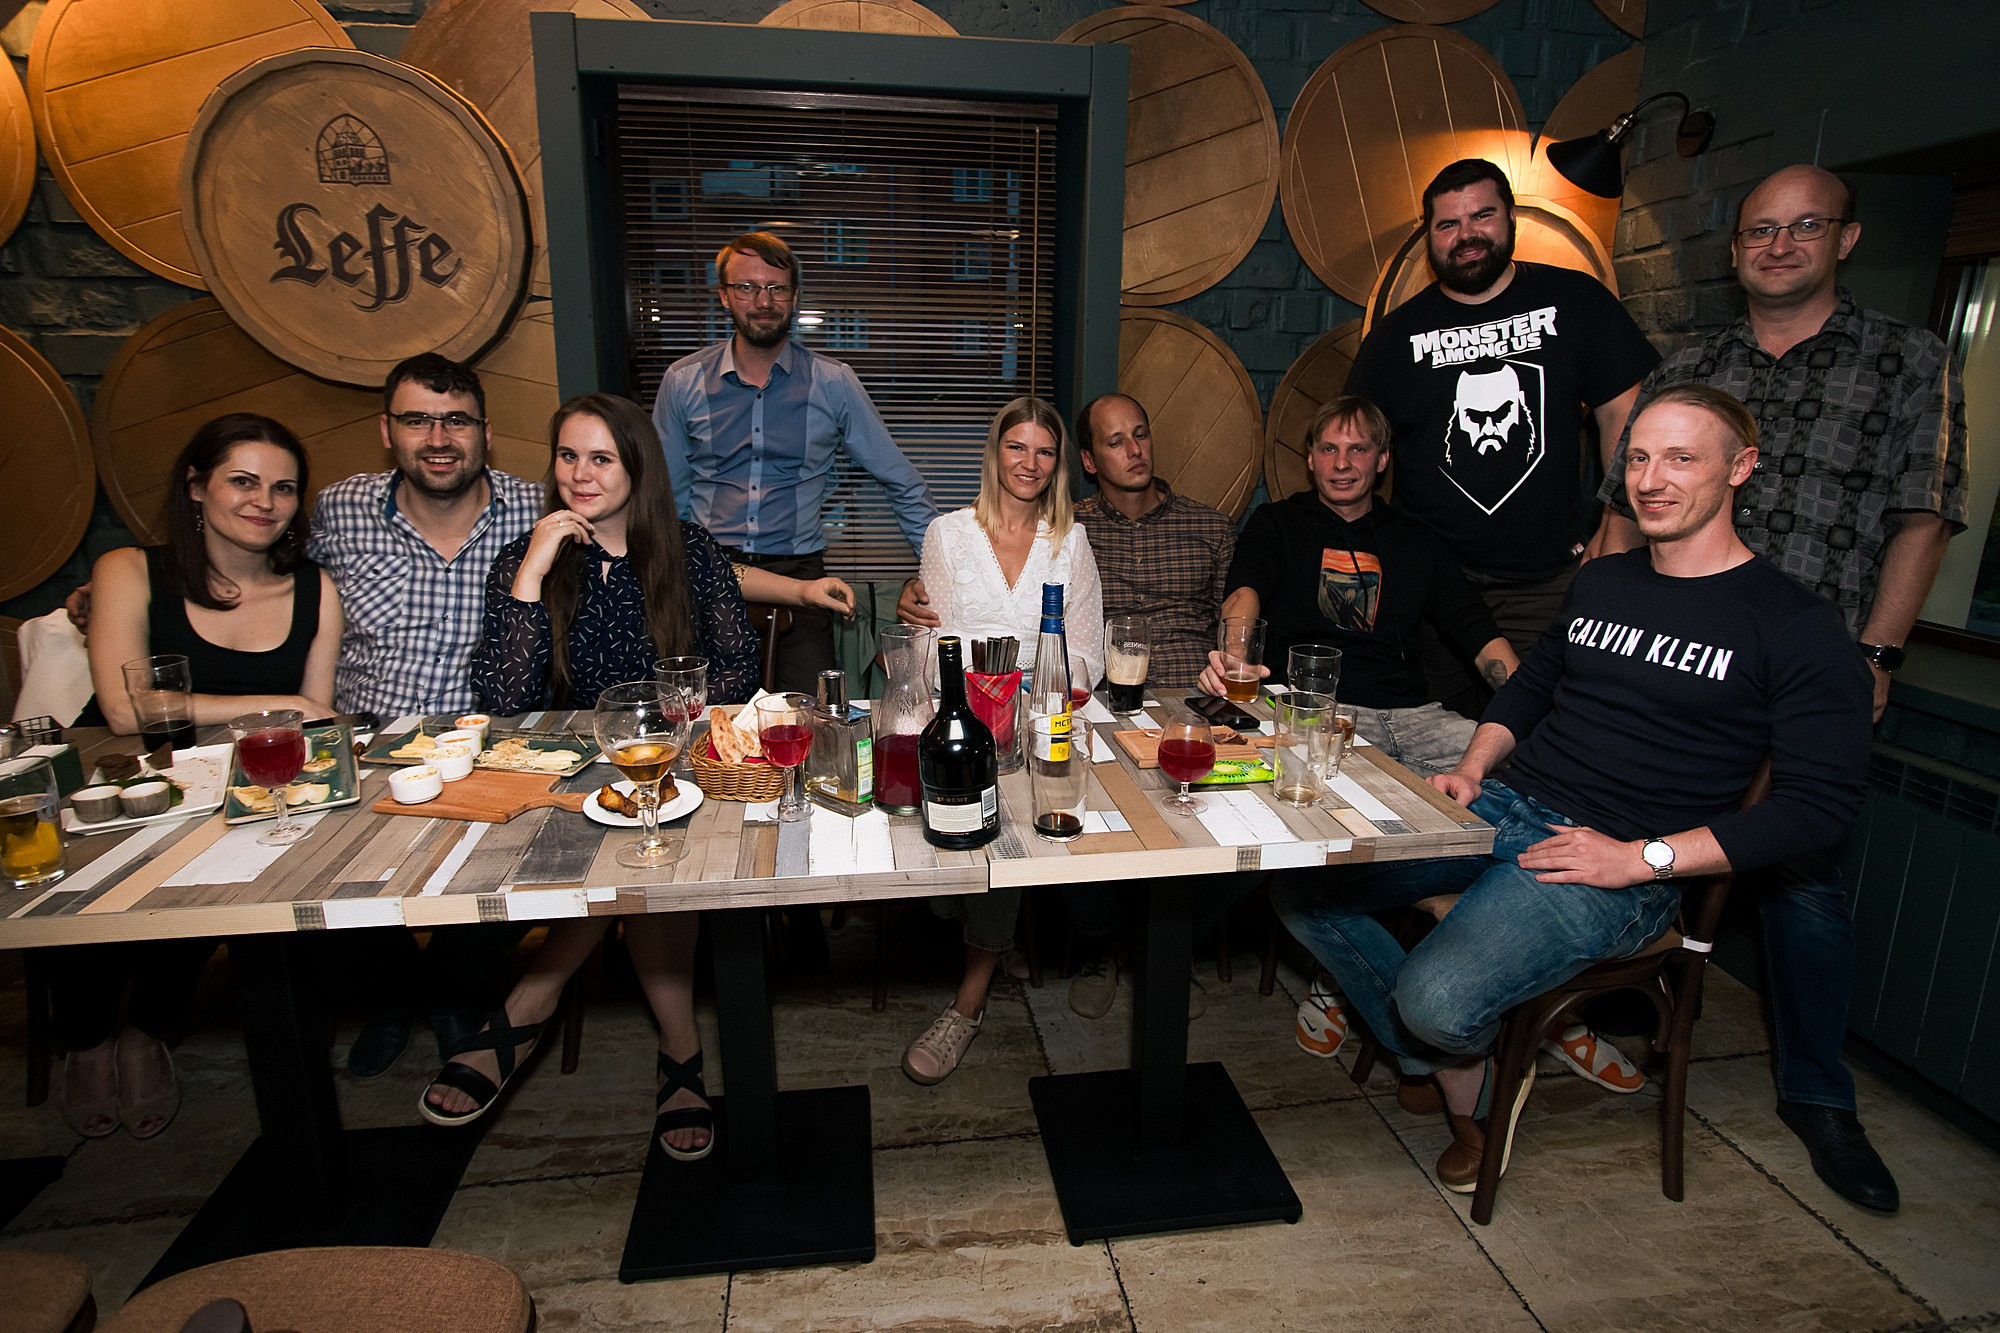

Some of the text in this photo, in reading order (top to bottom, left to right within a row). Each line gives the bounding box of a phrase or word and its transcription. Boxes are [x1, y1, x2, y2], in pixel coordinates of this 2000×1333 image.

[269, 202, 462, 312] Leffe
[1409, 305, 1558, 363] MONSTER
[1431, 331, 1542, 365] AMONG US
[1567, 616, 1734, 681] CALVIN KLEIN
